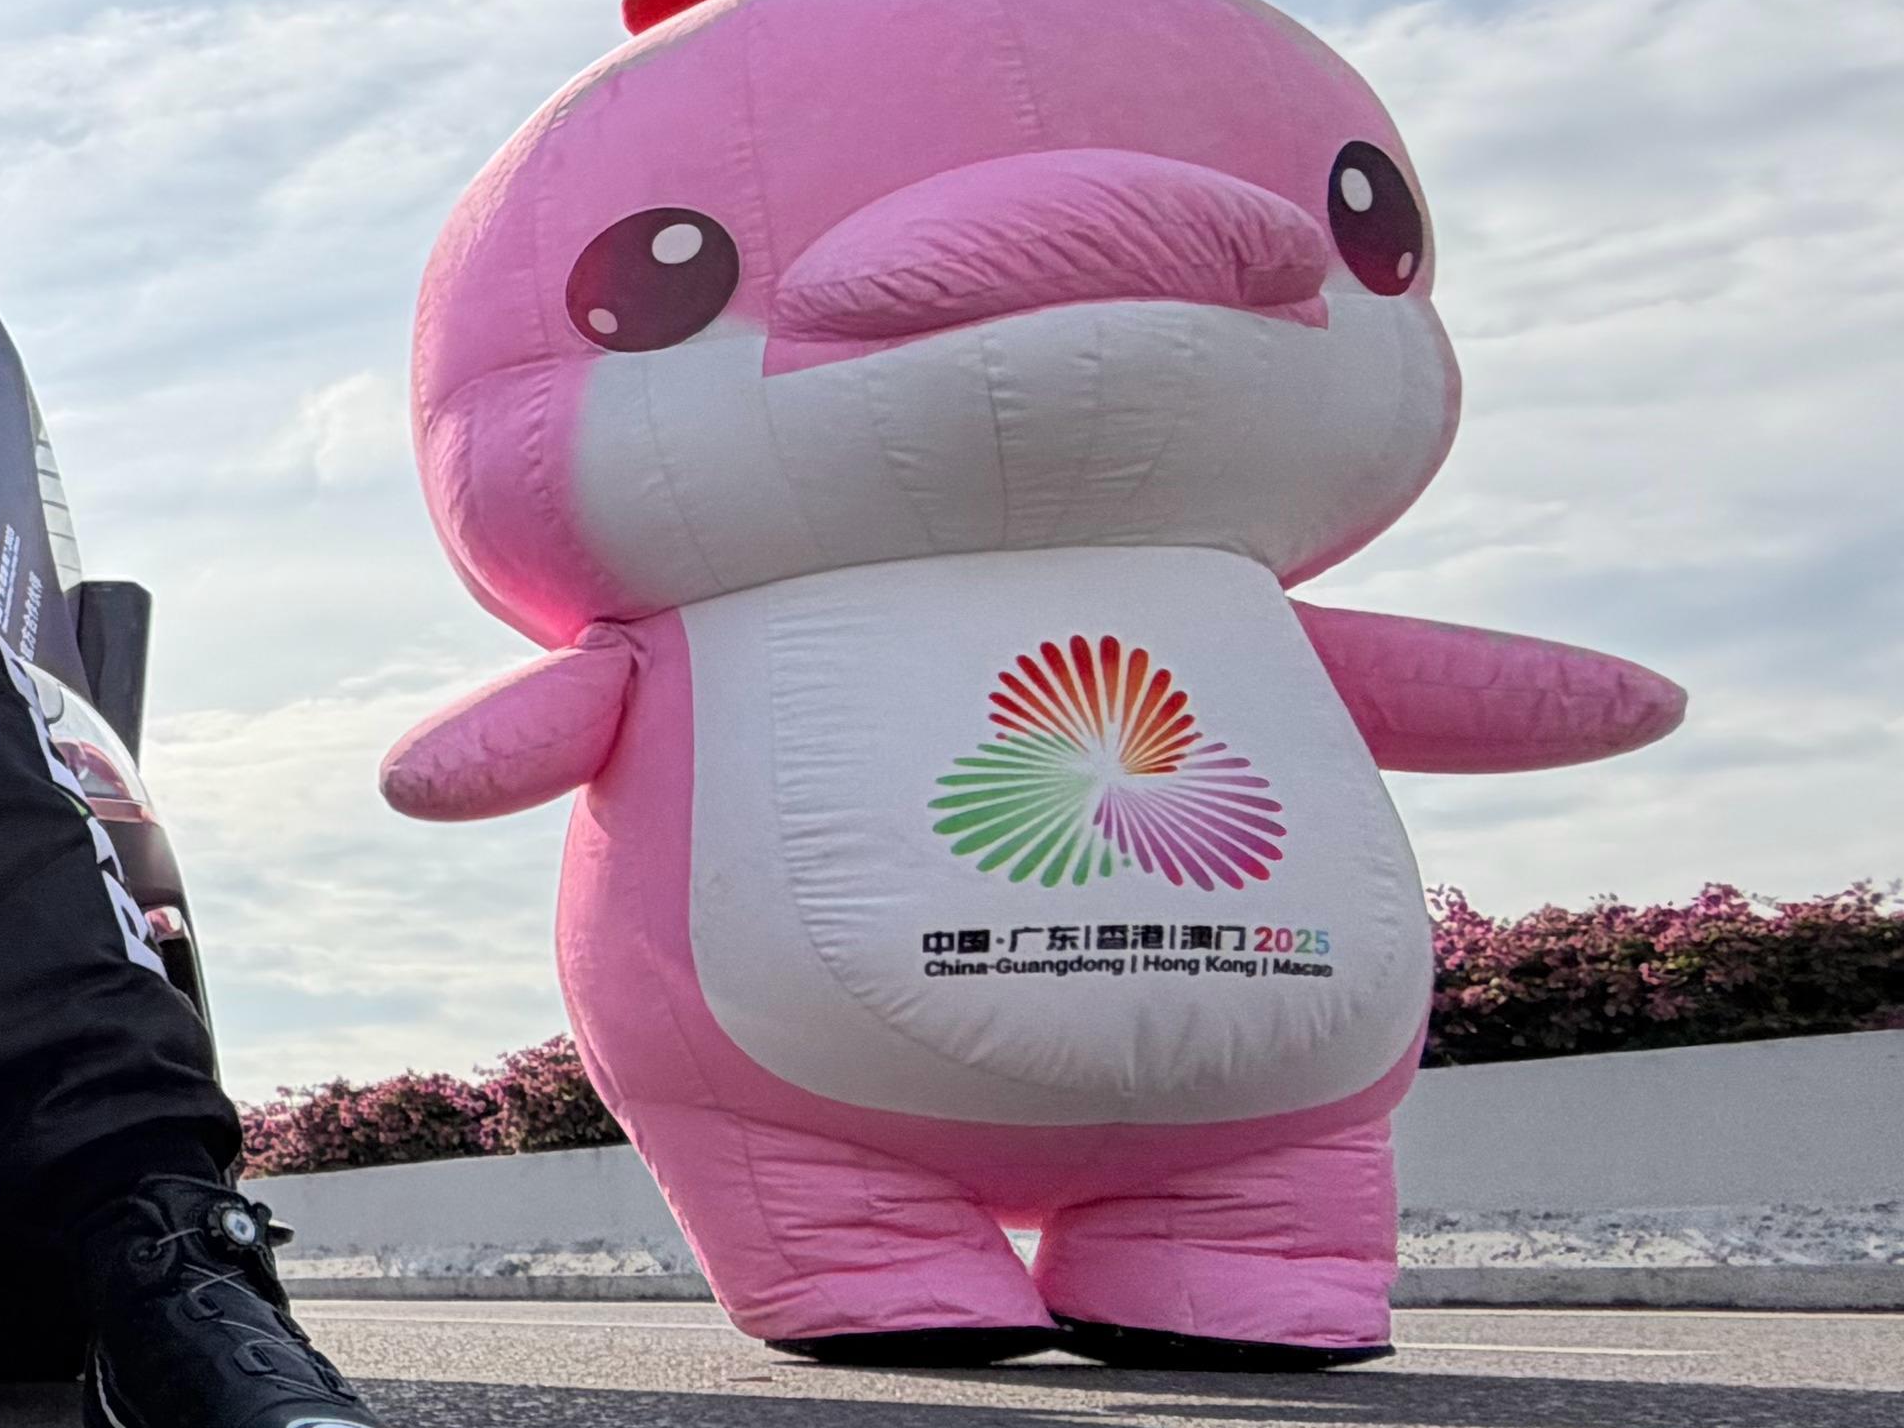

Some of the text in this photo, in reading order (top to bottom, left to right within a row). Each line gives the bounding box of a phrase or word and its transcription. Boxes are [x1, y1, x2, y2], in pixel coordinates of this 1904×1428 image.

[1254, 926, 1331, 955] 2025
[1143, 955, 1201, 976] Hong
[1205, 956, 1257, 978] Kong
[1272, 958, 1334, 977] Macao
